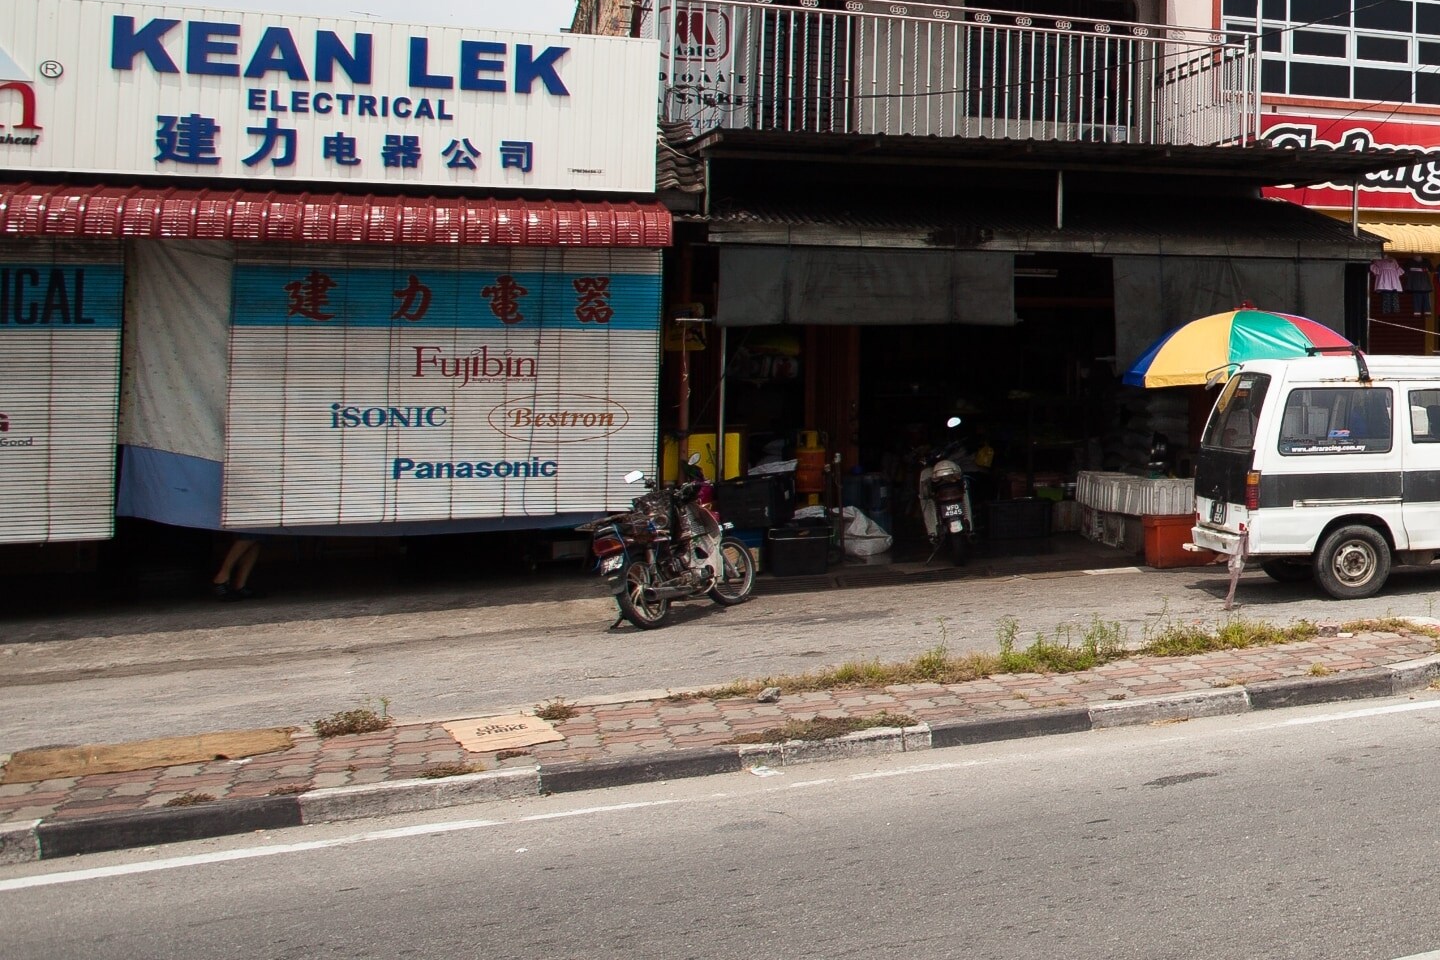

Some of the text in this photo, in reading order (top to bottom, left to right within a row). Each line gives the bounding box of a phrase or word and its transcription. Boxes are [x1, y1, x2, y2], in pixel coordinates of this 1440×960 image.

[112, 14, 571, 96] KEAN LEK
[248, 88, 454, 120] ELECTRICAL
[155, 113, 534, 172] 建力电器公司
[283, 269, 614, 324] 建力電器
[412, 345, 538, 388] Fujibin
[331, 403, 447, 429] iSONIC
[507, 407, 615, 428] Bestron
[393, 456, 558, 480] Panasonic
